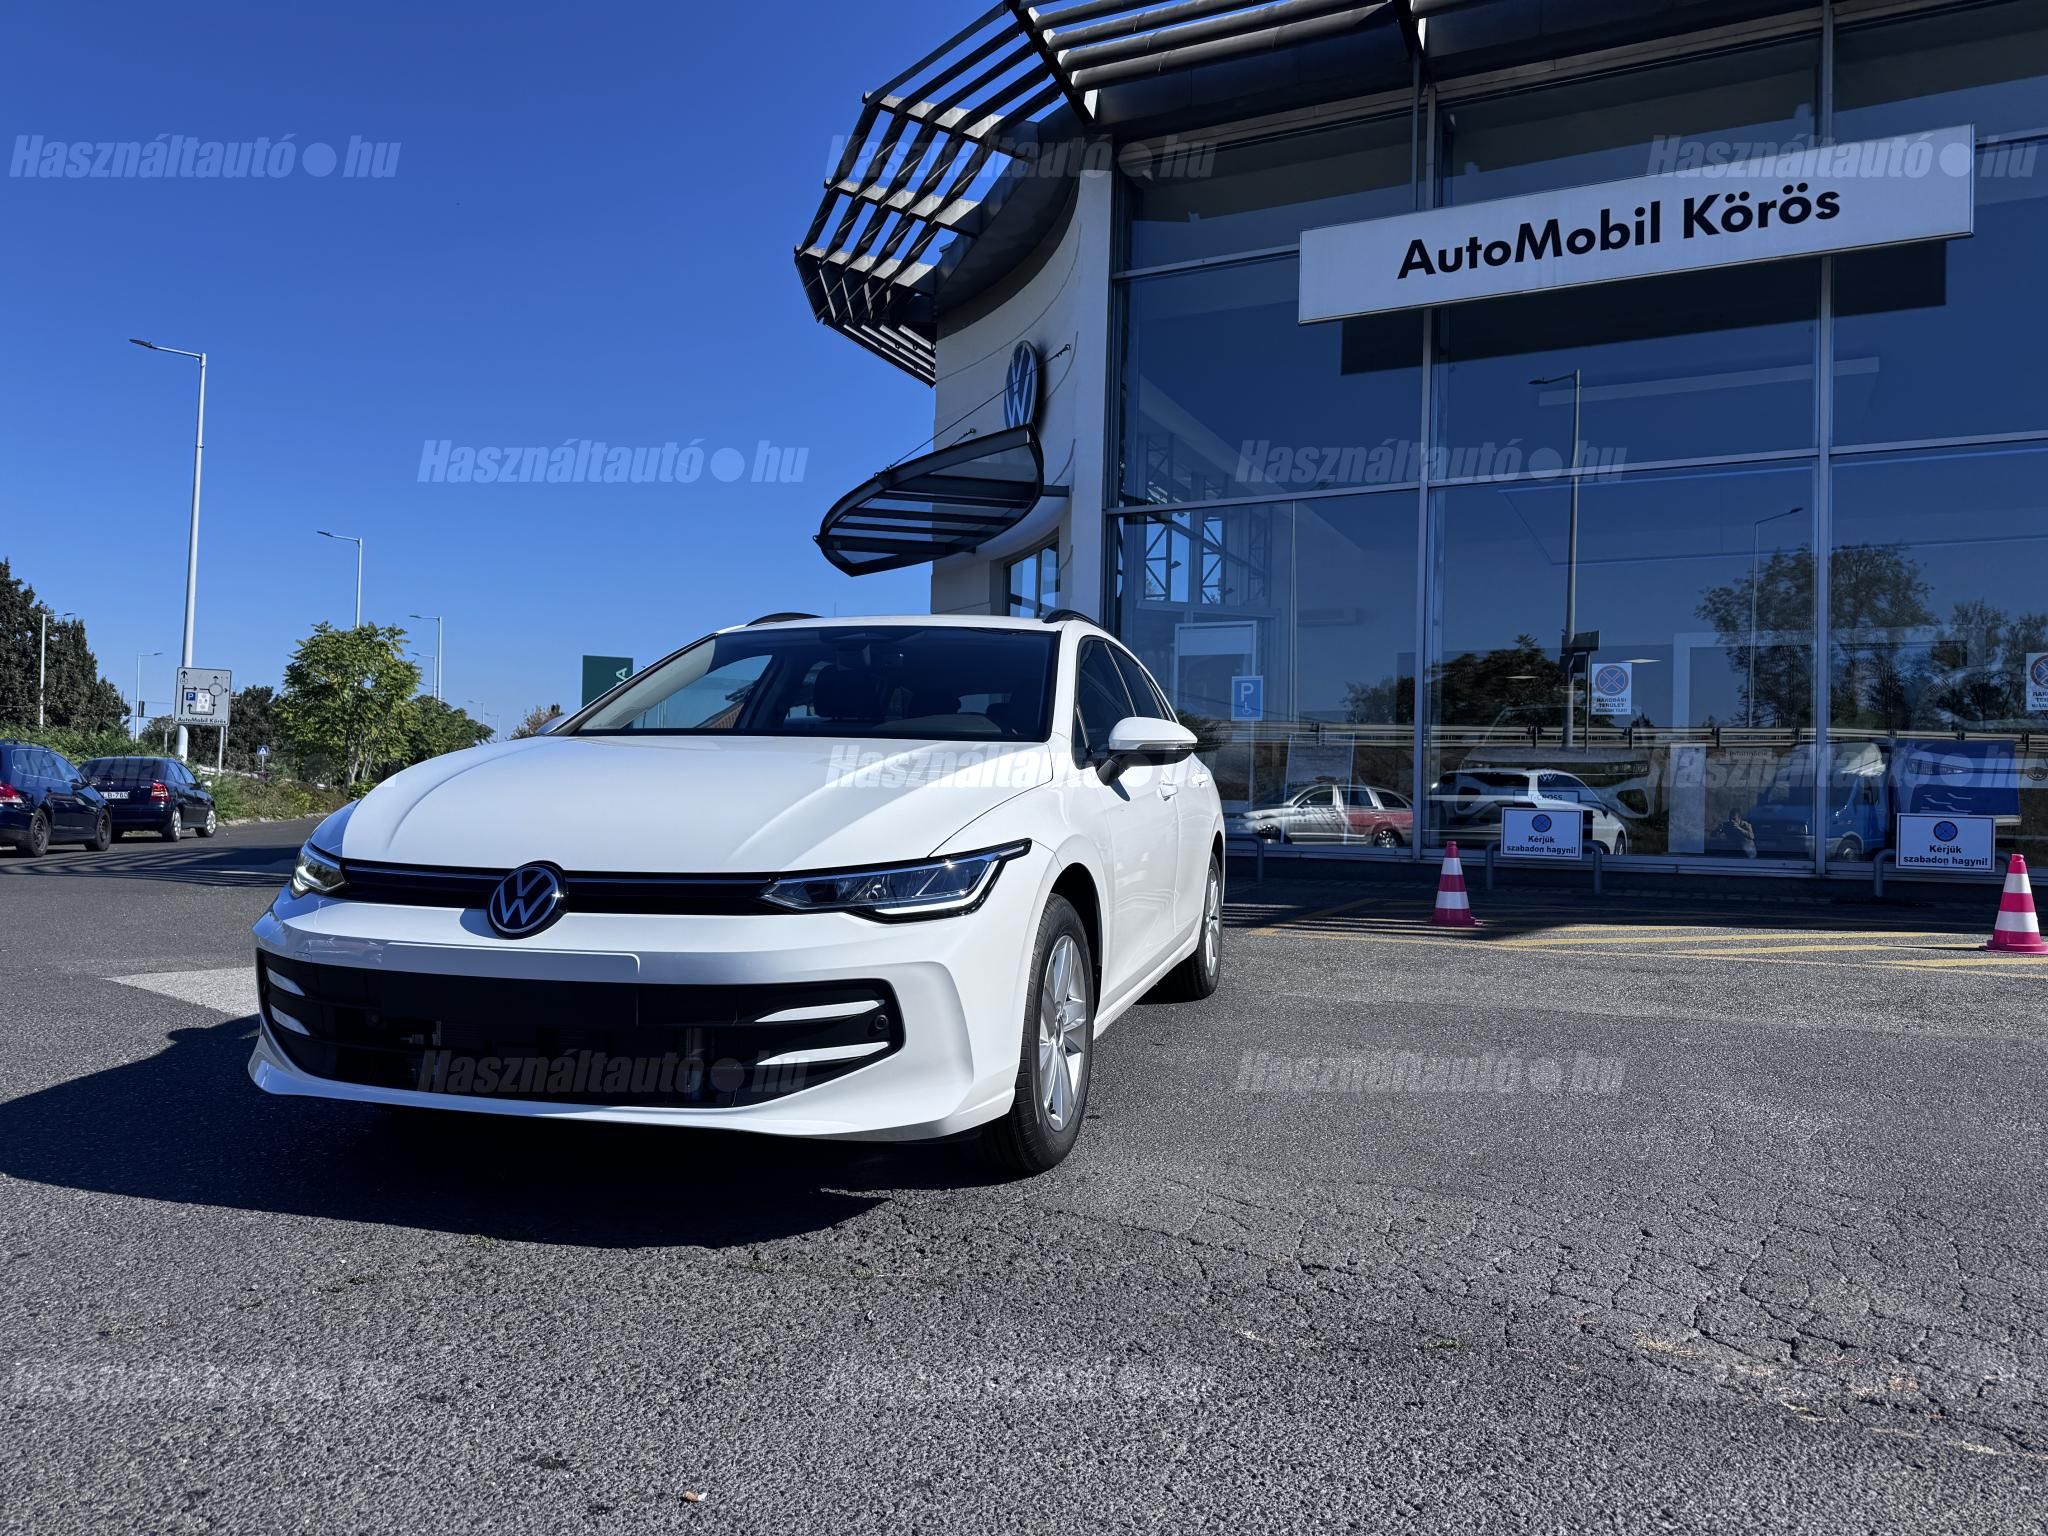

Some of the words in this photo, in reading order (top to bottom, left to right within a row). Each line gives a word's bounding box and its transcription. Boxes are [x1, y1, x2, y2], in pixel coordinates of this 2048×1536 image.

[1397, 201, 1661, 280] AutoMobil
[1682, 182, 1840, 239] Körös
[1241, 682, 1254, 702] P
[1528, 835, 1555, 845] Kérjük
[1506, 844, 1544, 853] szabadon
[1546, 845, 1577, 855] hagyni!
[1929, 844, 1962, 855] Kérjük
[1903, 855, 1949, 864] szabadon
[1951, 856, 1988, 867] hagyni!
